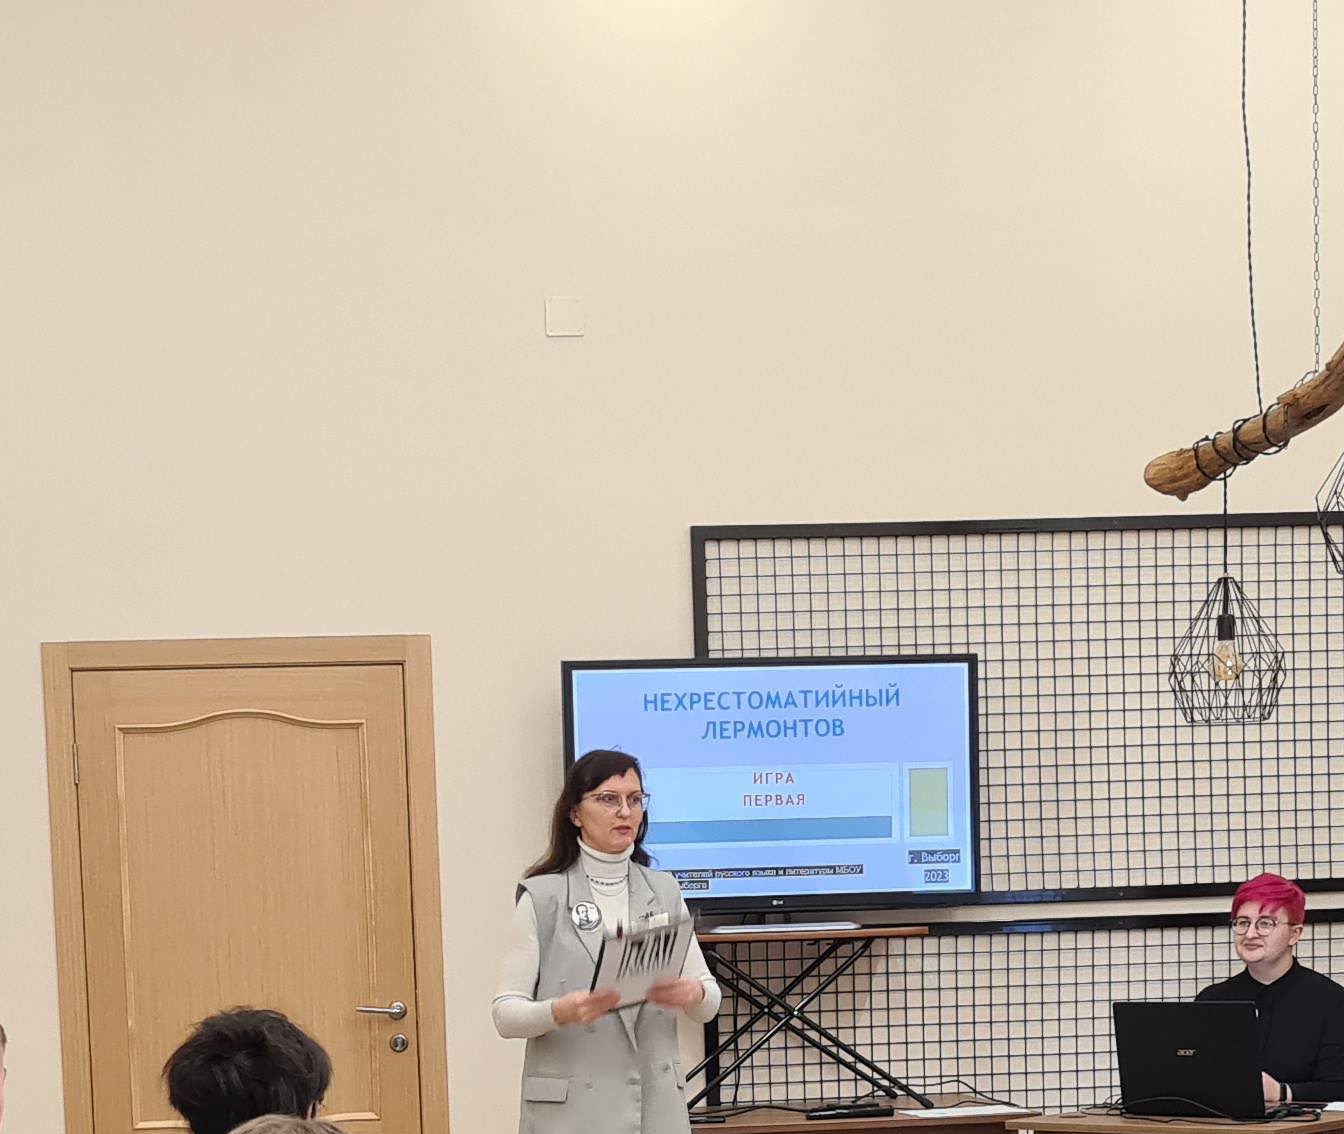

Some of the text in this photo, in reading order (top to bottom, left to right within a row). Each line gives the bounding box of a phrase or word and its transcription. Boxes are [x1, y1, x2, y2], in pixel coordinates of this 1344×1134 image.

[643, 683, 901, 712] НЕХРЕСТОМАТИЙНЫЙ
[701, 718, 846, 740] ЛЕРМОНТОВ
[753, 772, 795, 785] ИГРА
[743, 793, 807, 807] ПЕРВАЯ
[921, 851, 960, 863] Выборг
[835, 864, 862, 874] МБОУ
[924, 871, 949, 882] 2023
